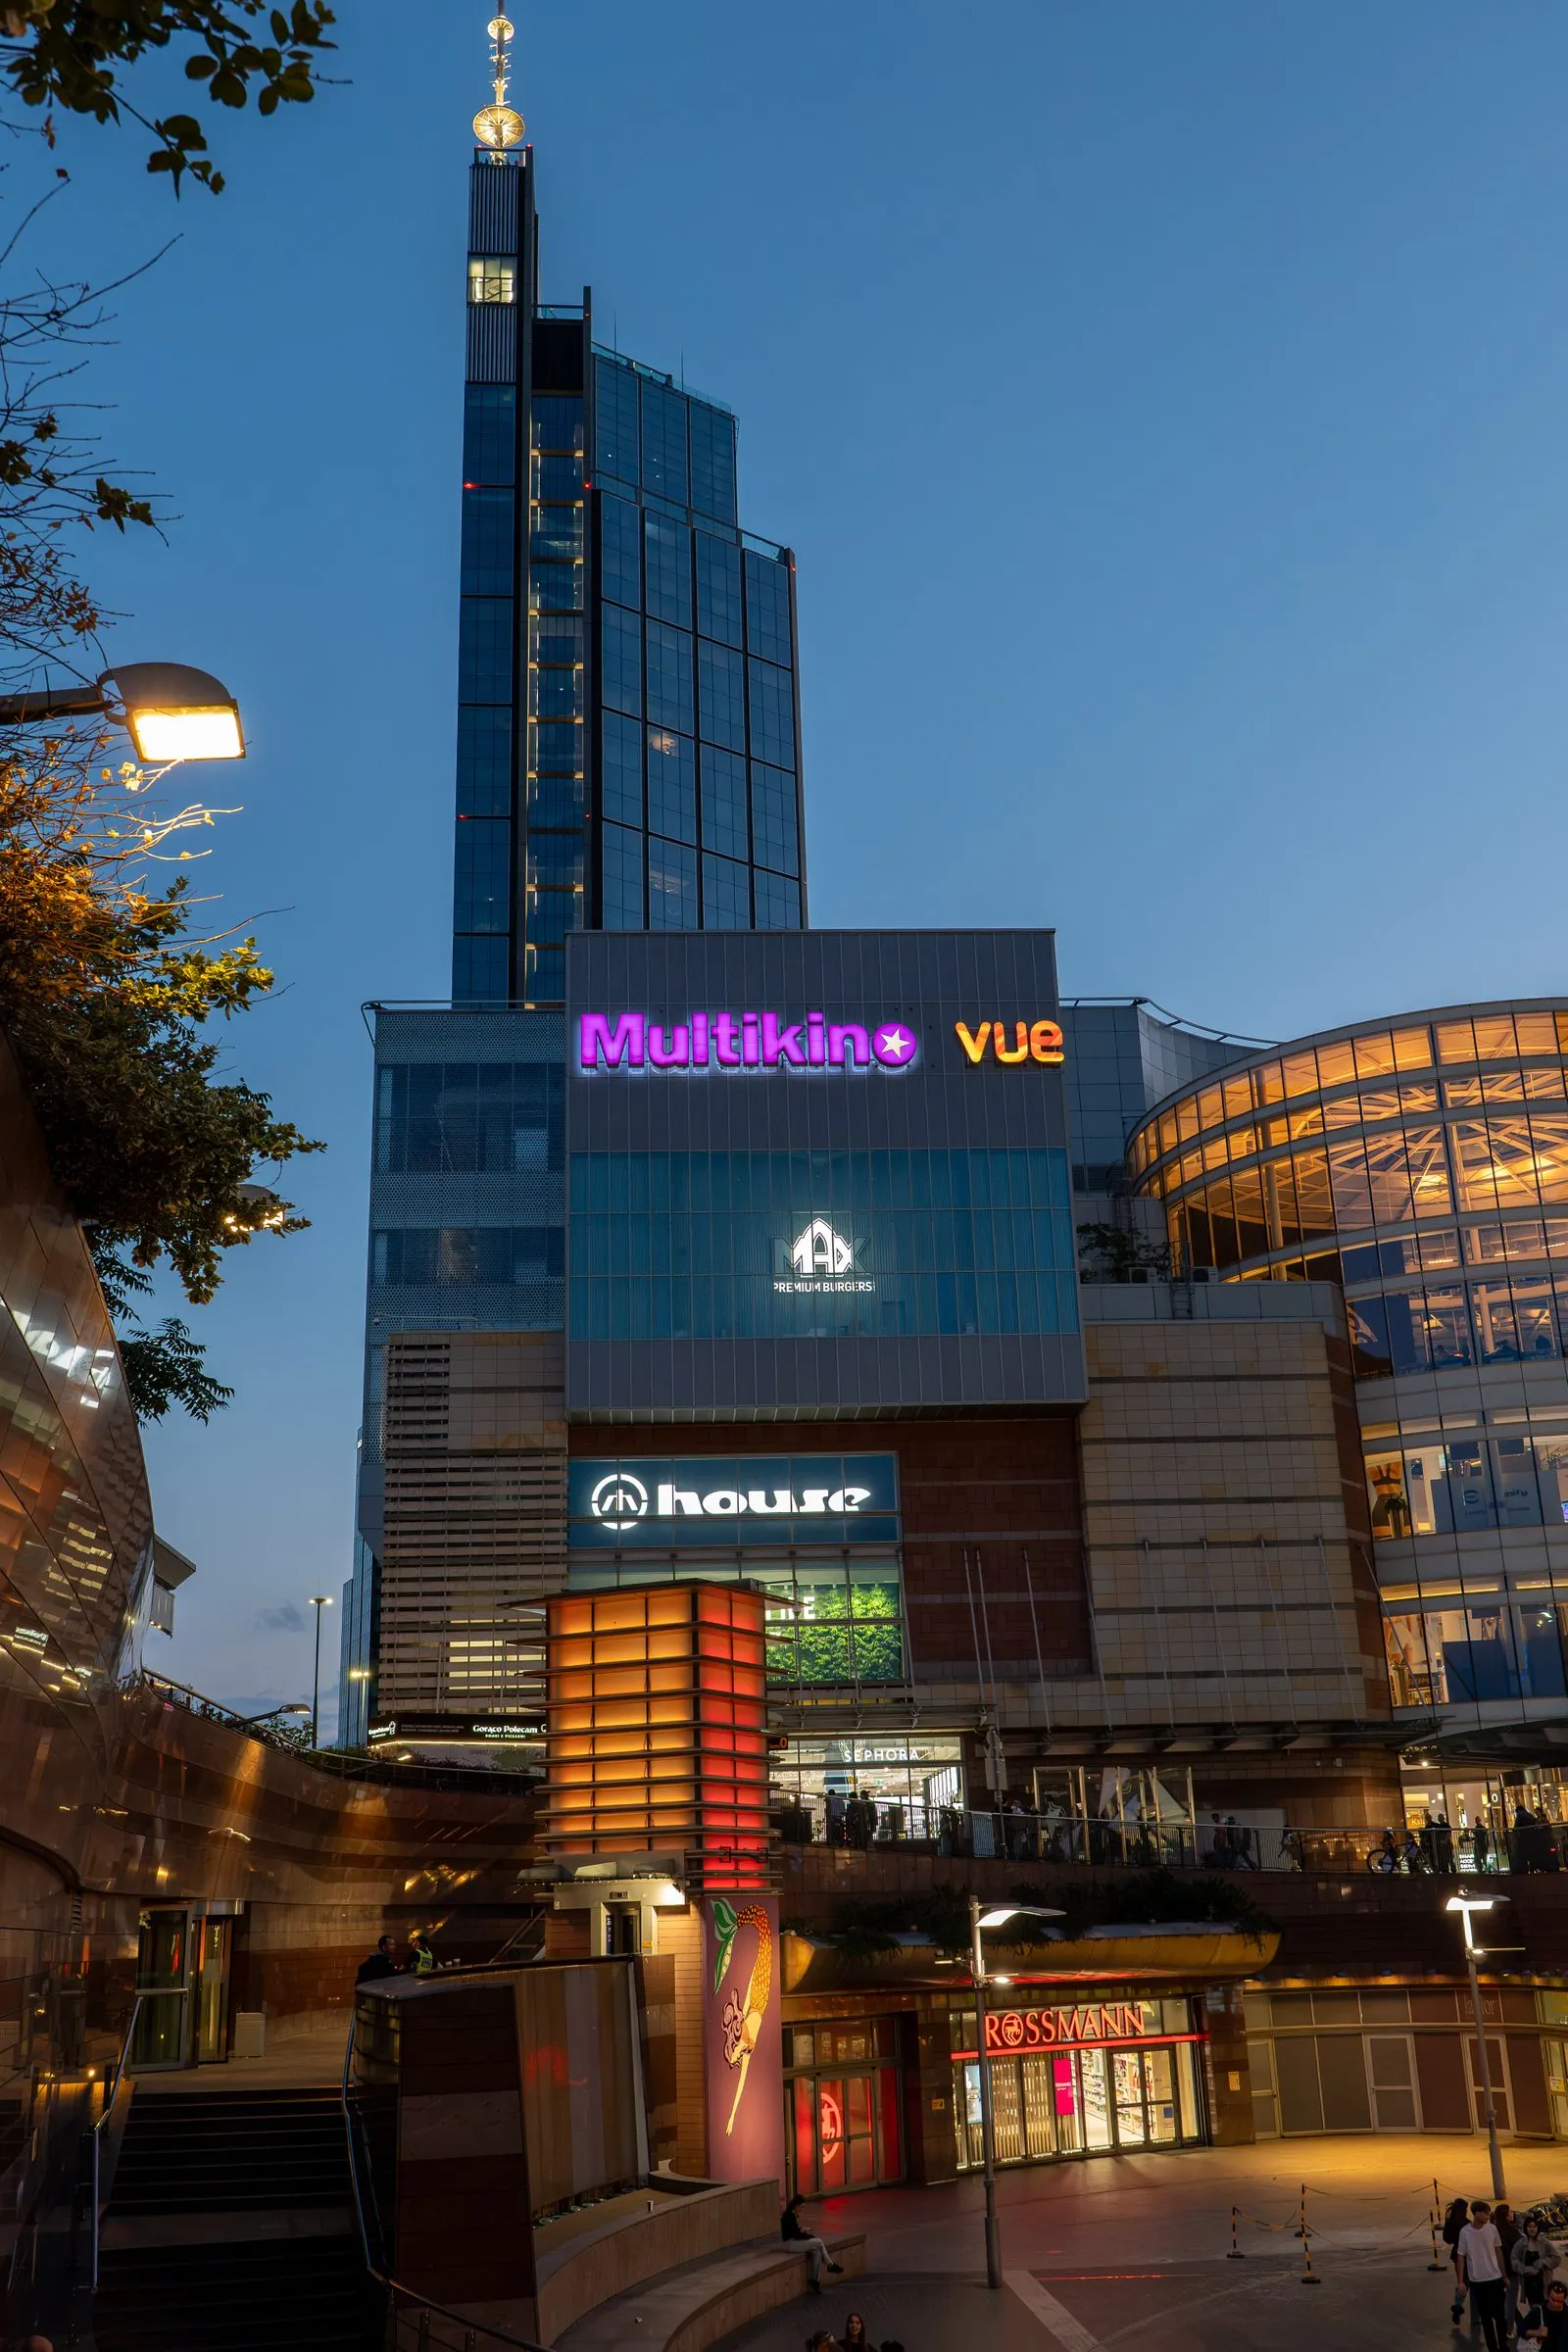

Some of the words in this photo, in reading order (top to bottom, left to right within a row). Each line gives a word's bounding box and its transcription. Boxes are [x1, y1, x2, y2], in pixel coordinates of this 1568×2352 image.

[580, 1012, 917, 1067] Multikino
[956, 1019, 1066, 1064] vue
[774, 1282, 821, 1293] PREMIUM
[823, 1281, 873, 1292] BURGERS
[658, 1484, 871, 1515] house
[472, 1724, 502, 1734] Gorąco
[503, 1725, 538, 1734] Polecam
[844, 1748, 919, 1763] SEPHORA
[985, 2005, 1146, 2047] ROSSMANN
